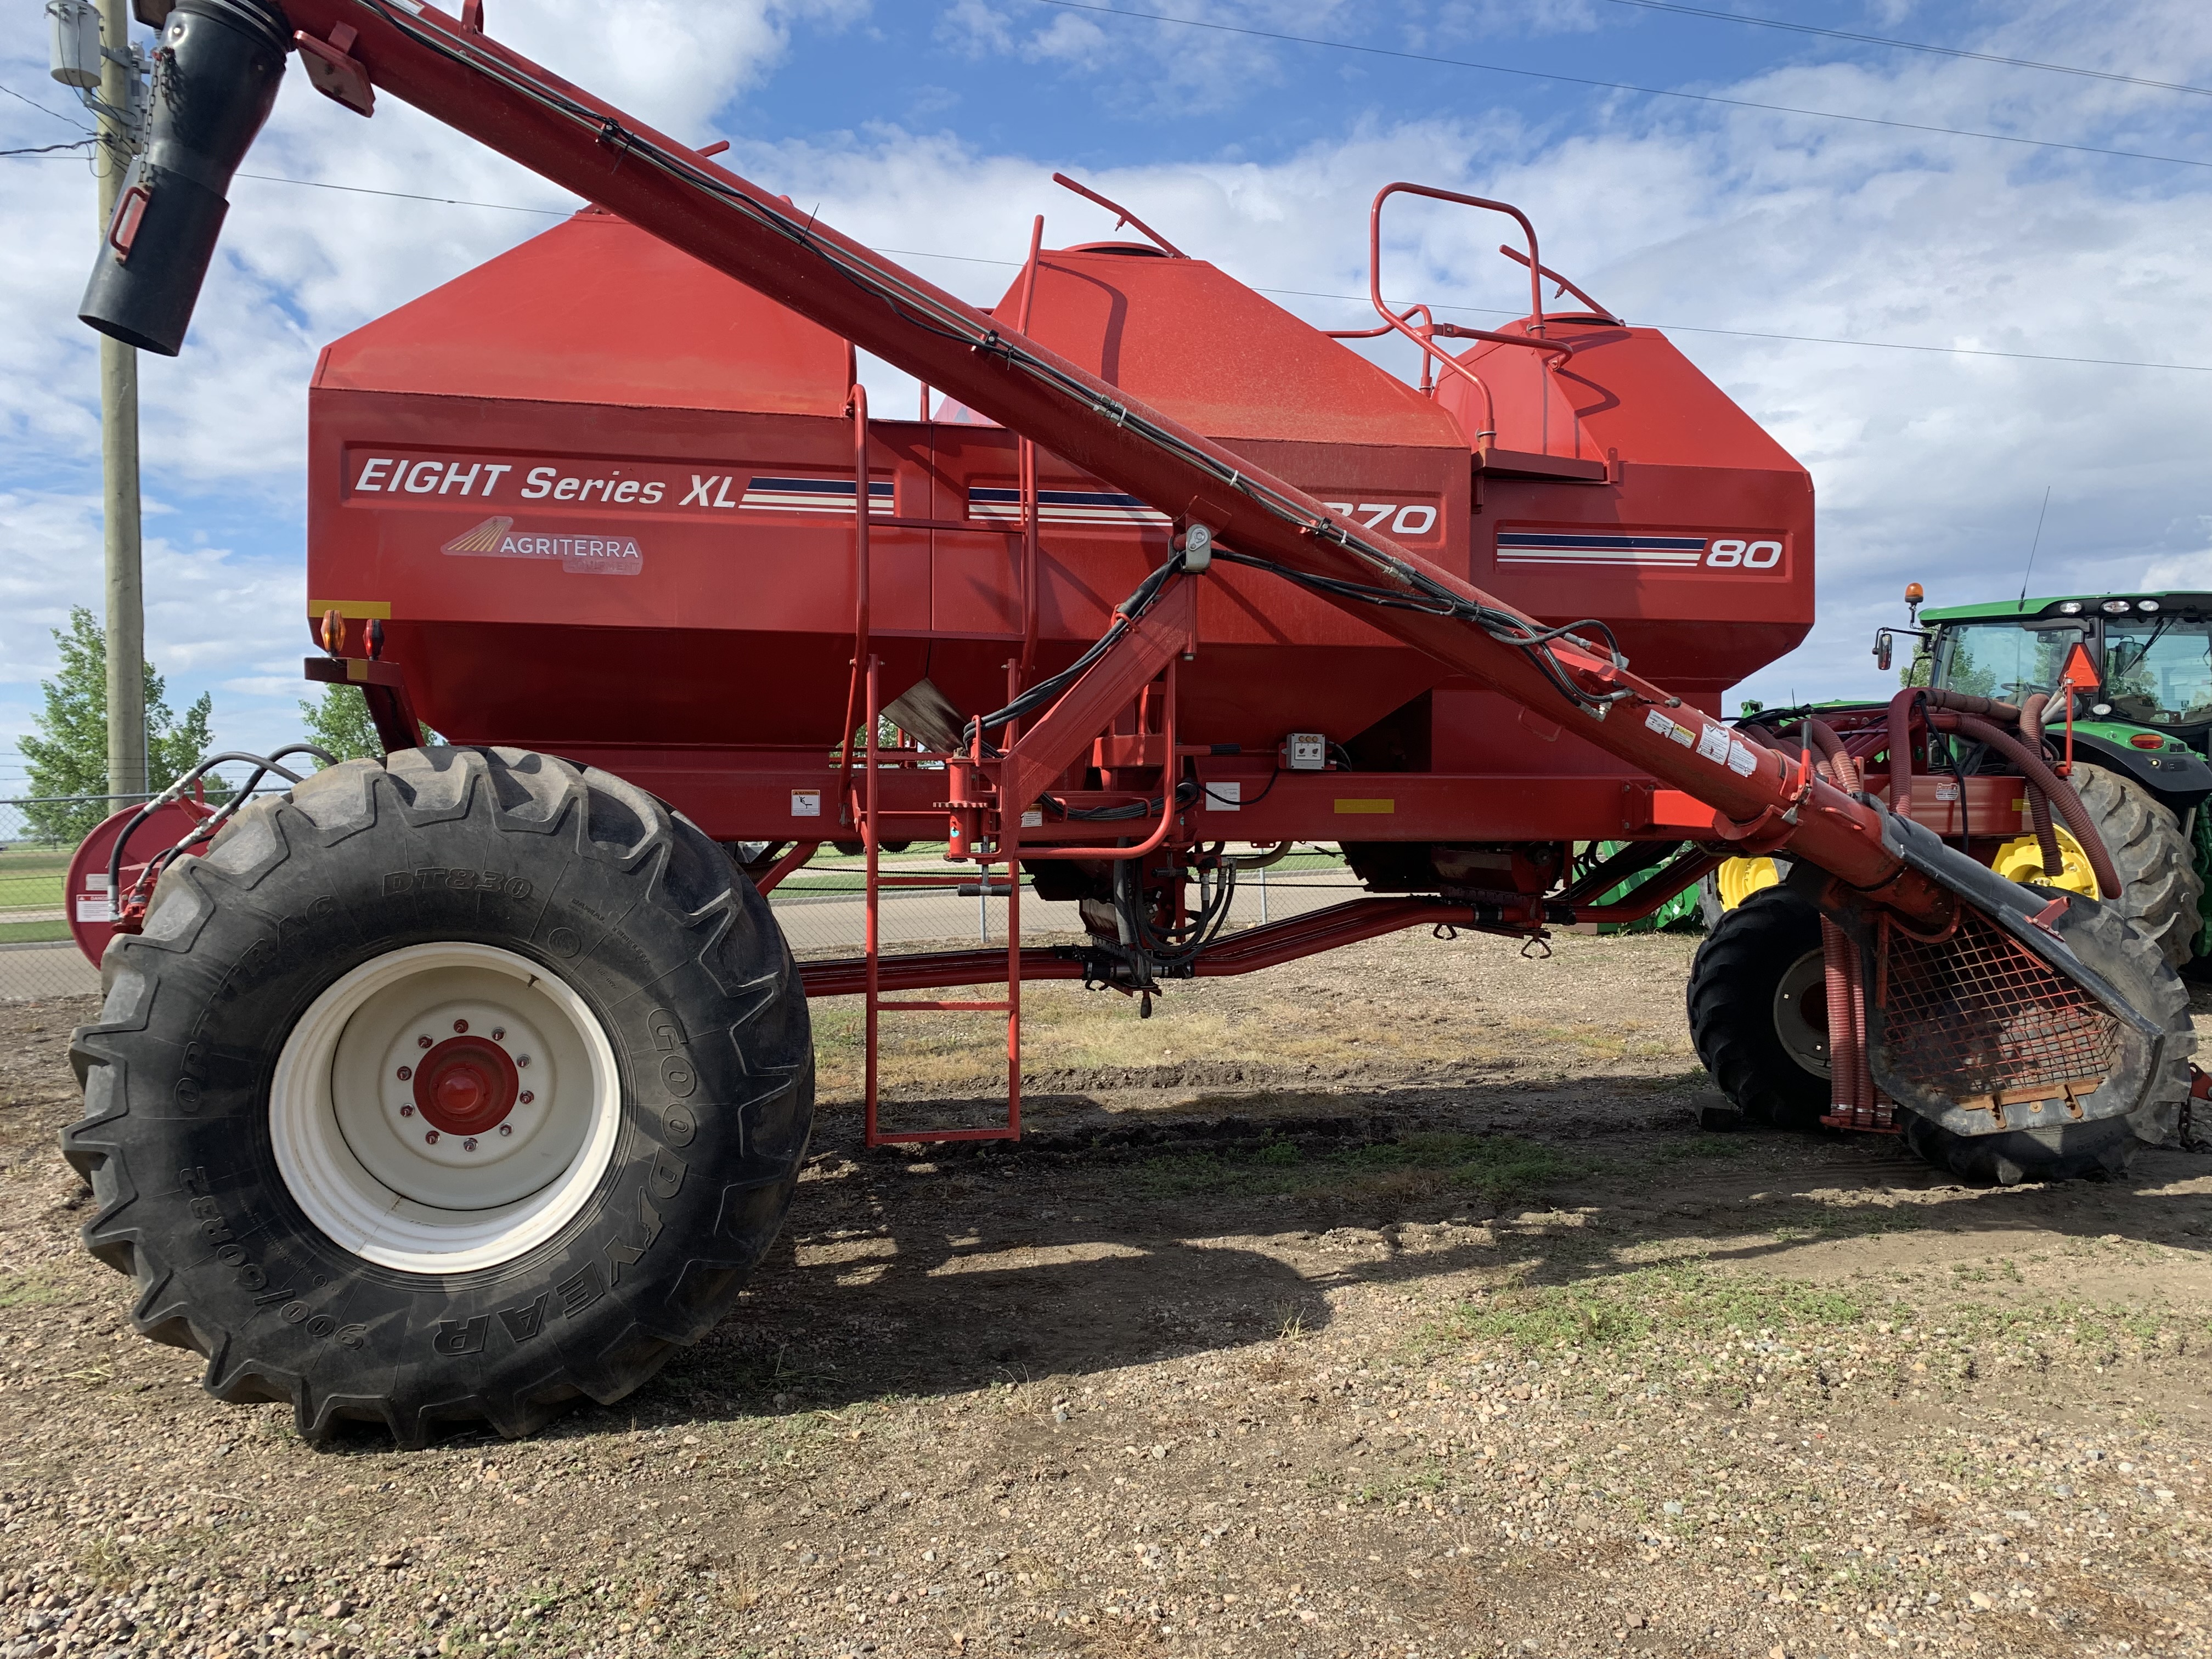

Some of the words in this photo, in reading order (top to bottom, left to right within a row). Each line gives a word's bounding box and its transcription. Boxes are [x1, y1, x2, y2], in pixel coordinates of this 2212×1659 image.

[355, 458, 512, 496] EIGHT
[521, 467, 665, 504] Series
[678, 475, 736, 508] XL
[499, 537, 639, 558] AGRITERRA
[1706, 539, 1782, 568] 80
[568, 561, 640, 571] EQUIPMENT
[382, 867, 532, 899] DT830
[174, 895, 335, 1113] OPTITRAC
[179, 1166, 367, 1350] 900/60R32
